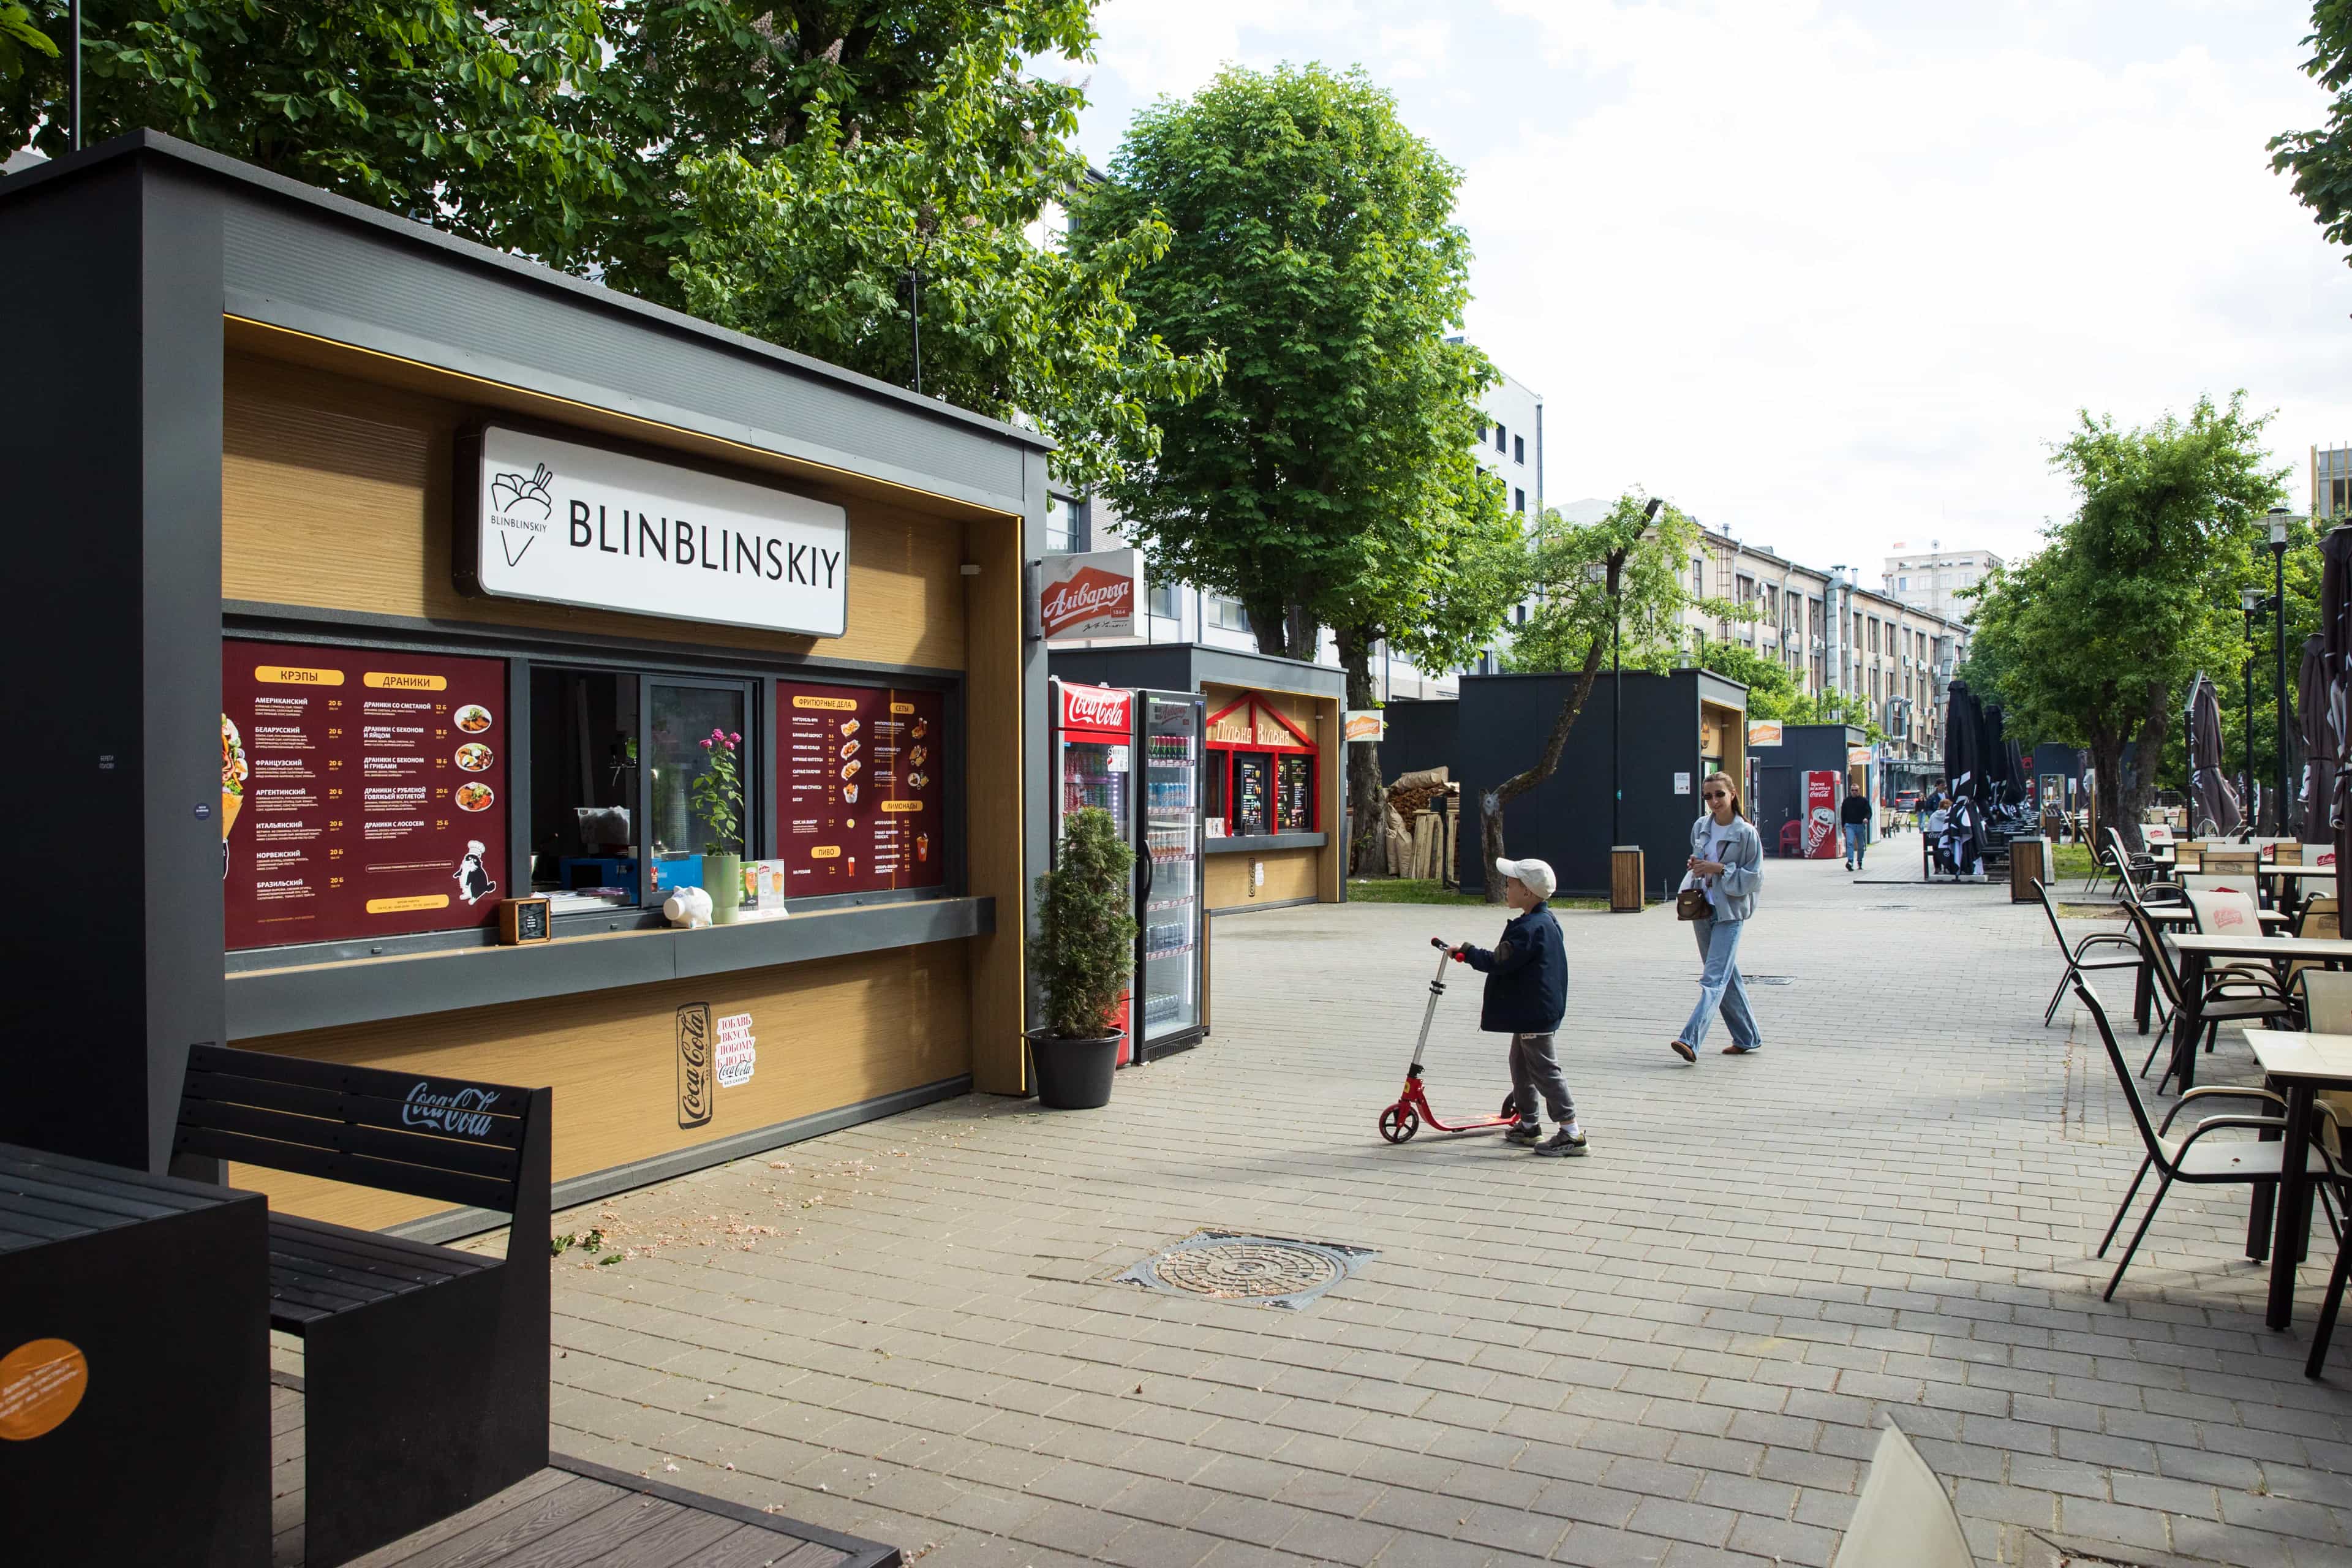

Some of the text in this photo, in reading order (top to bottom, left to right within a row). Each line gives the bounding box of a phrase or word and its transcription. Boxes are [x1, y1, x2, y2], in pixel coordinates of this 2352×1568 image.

[491, 515, 547, 533] BLINBLINSKIY
[570, 499, 840, 589] BLINBLINSKIY
[1043, 581, 1129, 613] Аліварыя
[281, 671, 318, 681] КРЭПЫ
[383, 676, 430, 687] ДРАНИКИ
[799, 698, 836, 707] ФРИТЮРНЫЕ
[1069, 688, 1126, 726] Coca-Cola
[257, 850, 300, 859] НОРВЕЖСКИЙ
[257, 878, 303, 888] БРАЗИЛЬСКИЙ
[723, 1029, 748, 1042] ВКУСА
[680, 1011, 705, 1120] Coca-Cola
[719, 1060, 752, 1080] Coca-Cola
[402, 1082, 501, 1136] Coca-Cola
